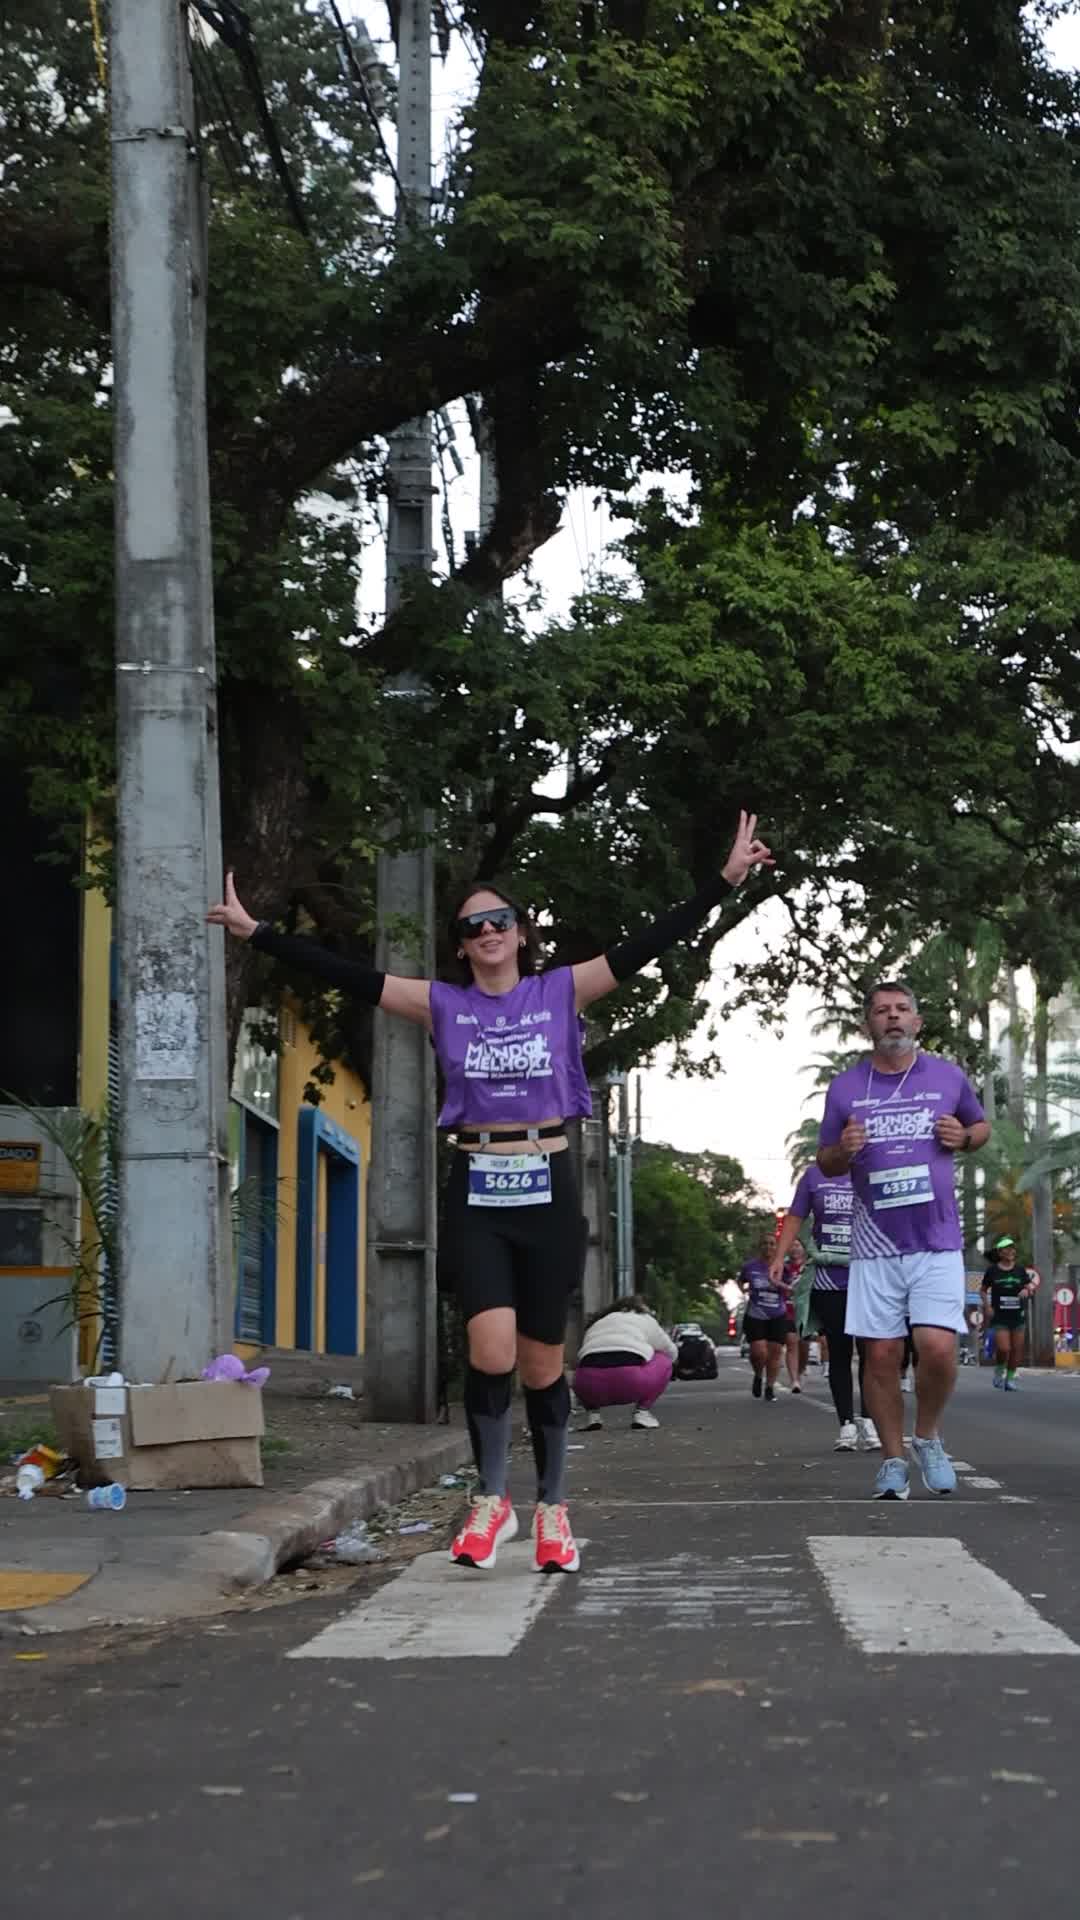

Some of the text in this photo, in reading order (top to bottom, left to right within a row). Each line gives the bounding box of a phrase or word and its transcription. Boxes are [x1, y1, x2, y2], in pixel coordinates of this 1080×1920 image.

[466, 1041, 537, 1061] MUNDO
[865, 1111, 927, 1128] MUNDO
[485, 1173, 532, 1189] 5626
[882, 1180, 917, 1194] 6337
